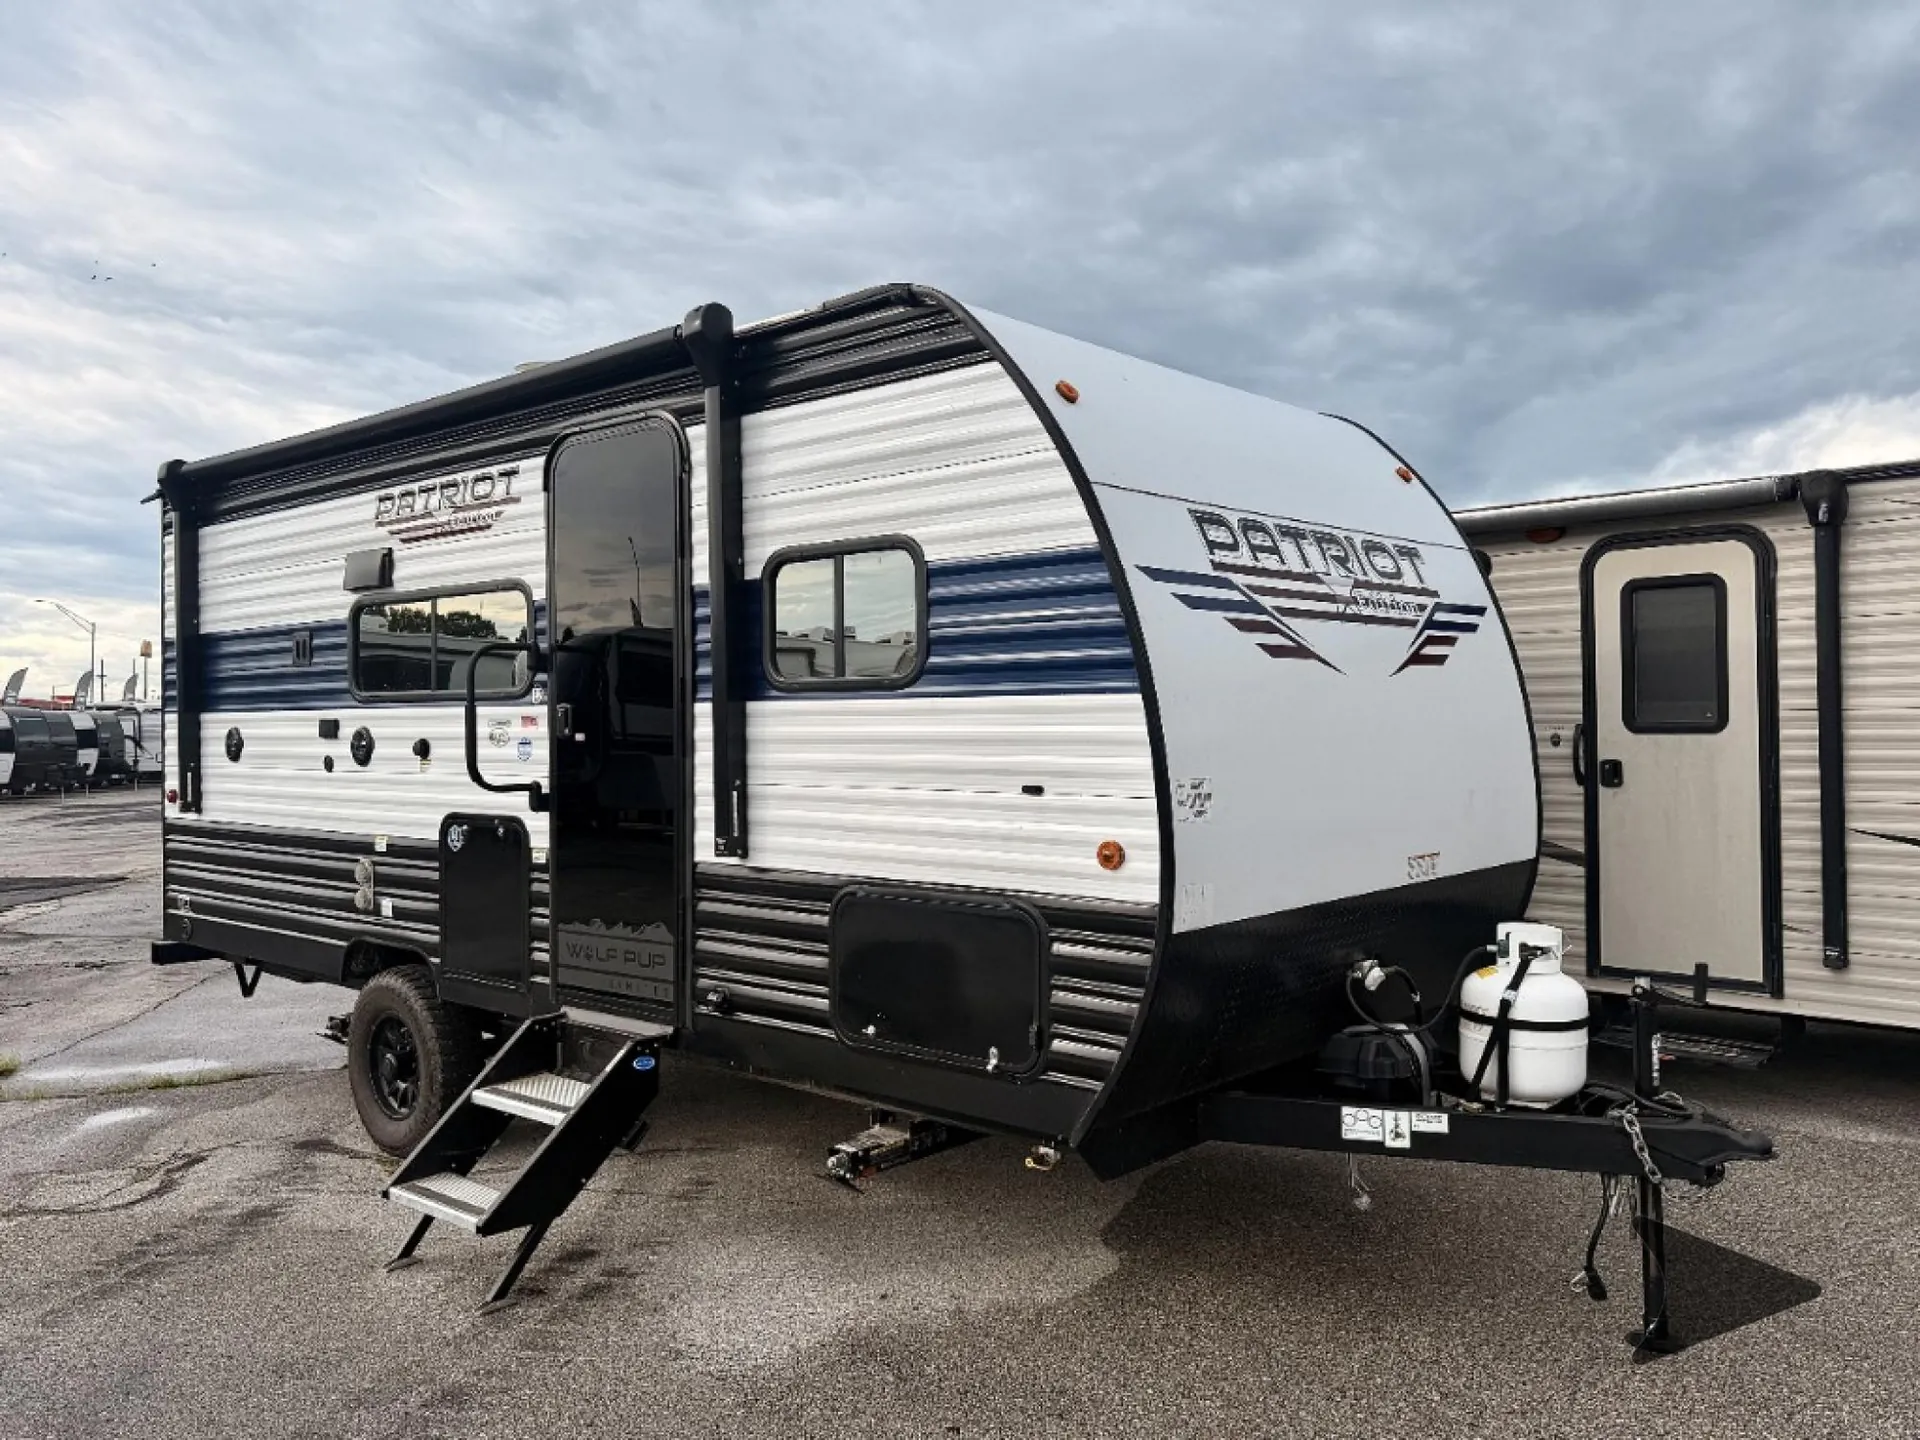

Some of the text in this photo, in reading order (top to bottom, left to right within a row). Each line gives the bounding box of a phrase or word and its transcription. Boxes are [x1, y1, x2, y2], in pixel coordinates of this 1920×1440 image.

[375, 465, 520, 519] PATRIOT
[1187, 508, 1426, 586] PATRIOT
[624, 950, 667, 969] PUP
